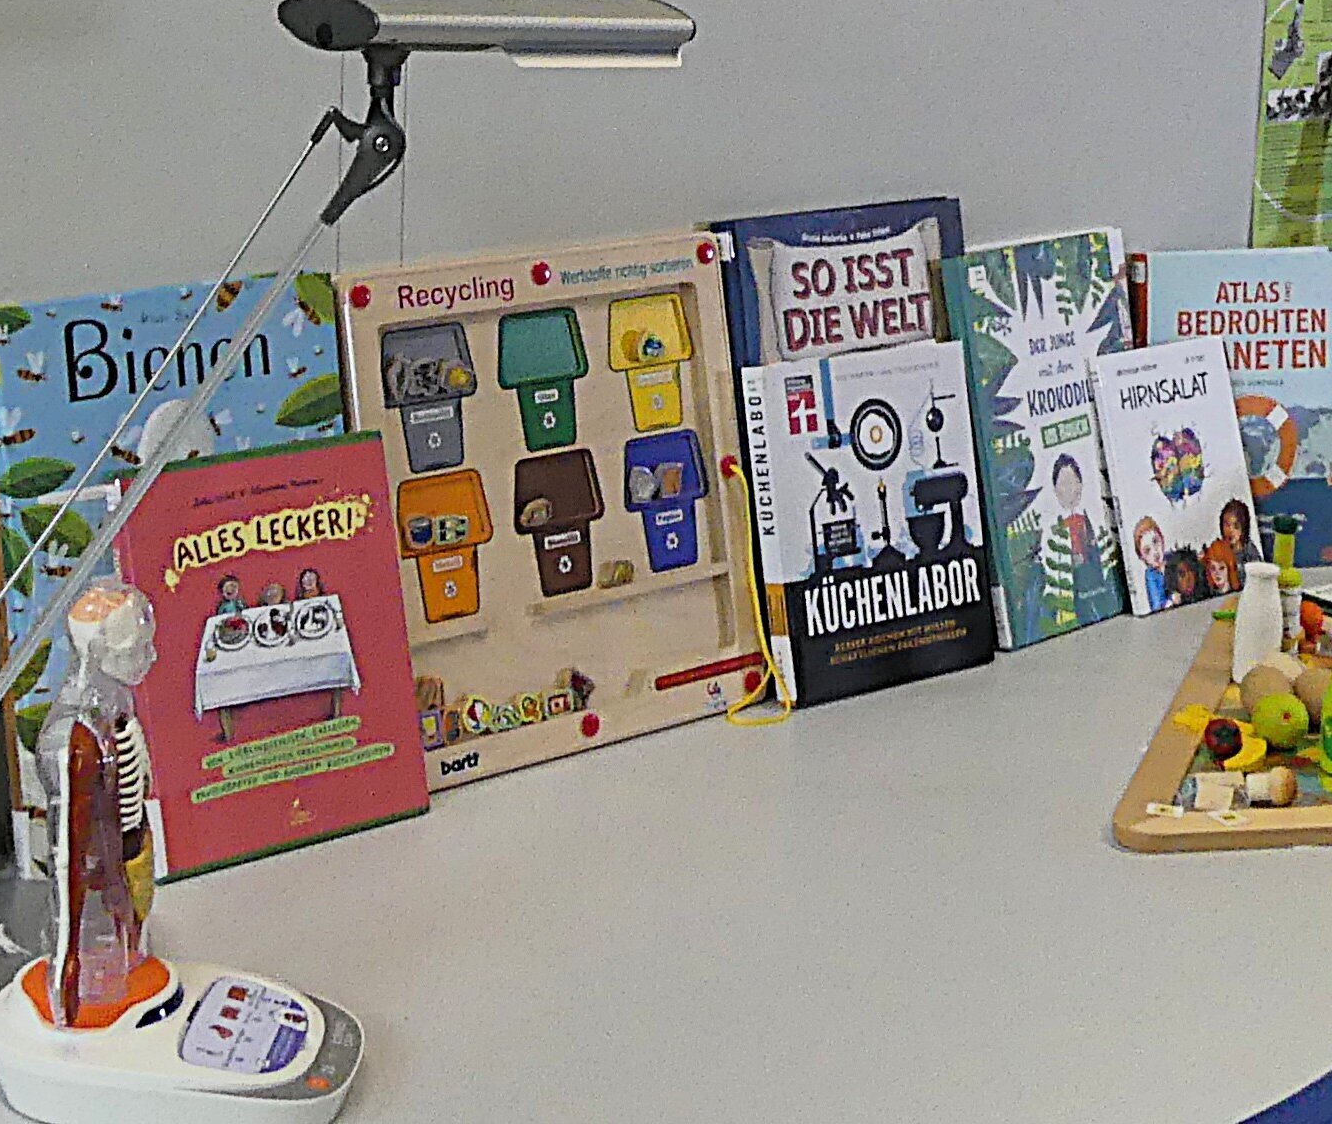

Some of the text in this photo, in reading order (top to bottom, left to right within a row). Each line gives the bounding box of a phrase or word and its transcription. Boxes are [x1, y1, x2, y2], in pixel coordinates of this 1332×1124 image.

[397, 276, 516, 309] Recycling
[791, 247, 915, 300] SO ISST
[1216, 281, 1279, 304] ATLAS
[783, 292, 931, 352] DIE WELT
[1177, 309, 1326, 336] BEDROHTEN
[64, 319, 271, 403] Bienen
[1029, 338, 1047, 355] DER
[1222, 339, 1326, 370] NETEN
[1027, 379, 1095, 417] KROKODIL
[1120, 372, 1208, 410] HIRNSALAT
[177, 507, 352, 568] ALLES LECKER!
[805, 558, 980, 637] KÜCHENLABOR
